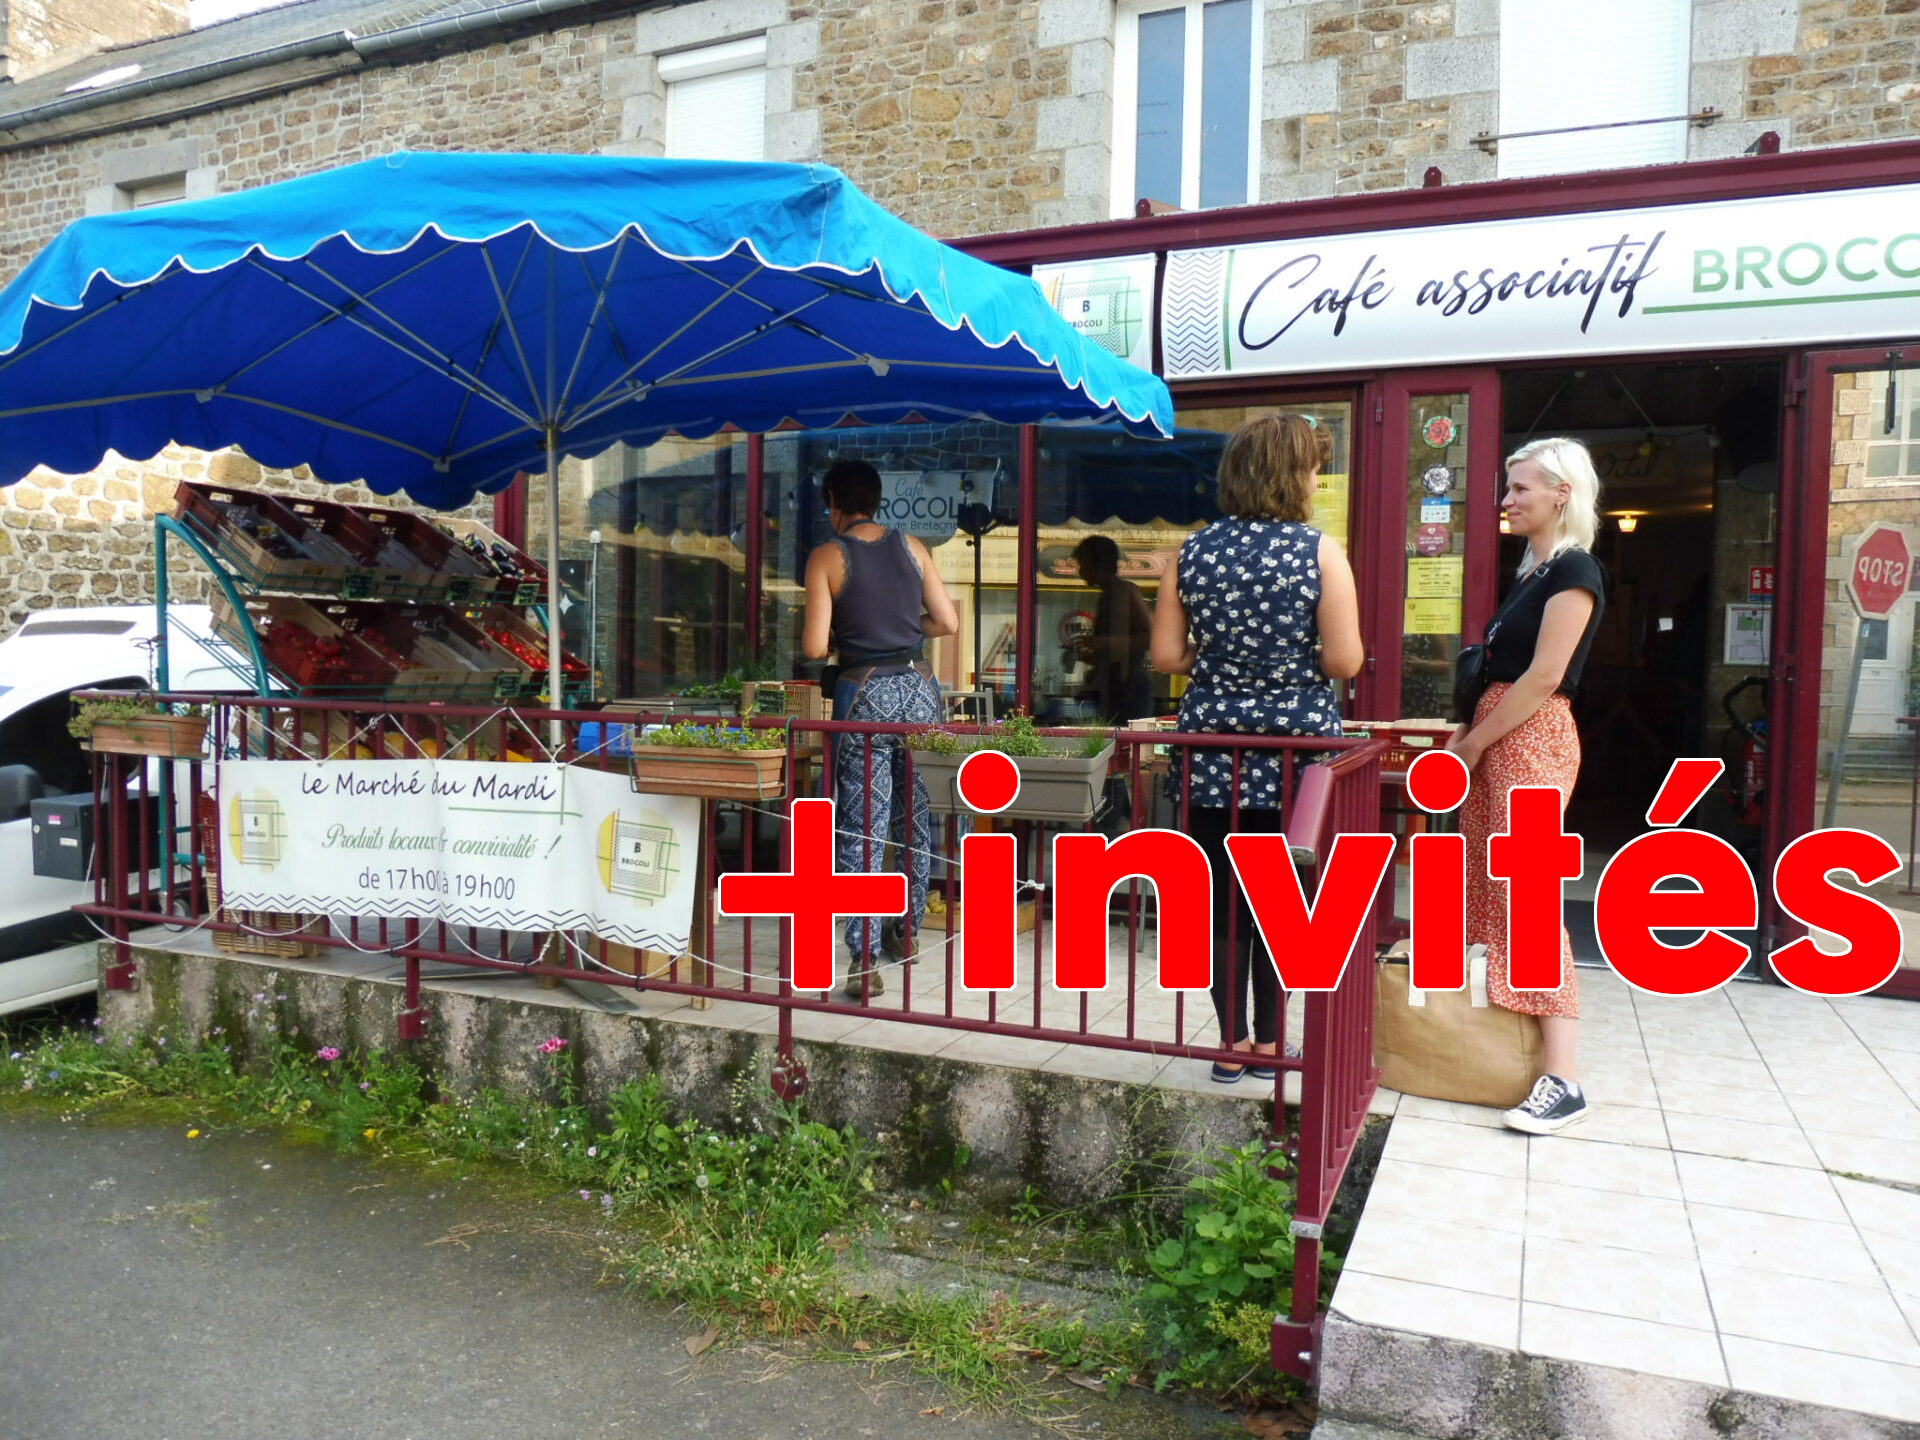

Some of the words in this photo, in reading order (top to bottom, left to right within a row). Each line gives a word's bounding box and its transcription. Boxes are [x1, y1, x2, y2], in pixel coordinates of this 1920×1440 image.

[1239, 254, 1392, 351] Café
[1416, 231, 1666, 334] associatif
[1082, 300, 1091, 313] B
[1068, 319, 1103, 328] ROCOLI
[876, 496, 968, 520] ROCOL
[336, 770, 426, 796] Marché
[431, 772, 466, 796] du
[472, 773, 557, 801] Mardi
[321, 823, 384, 850] Produits
[388, 827, 438, 851] locaux
[453, 834, 539, 859] convivialité
[633, 842, 642, 853] B
[621, 857, 650, 868] BROCOLI
[358, 866, 380, 889] de
